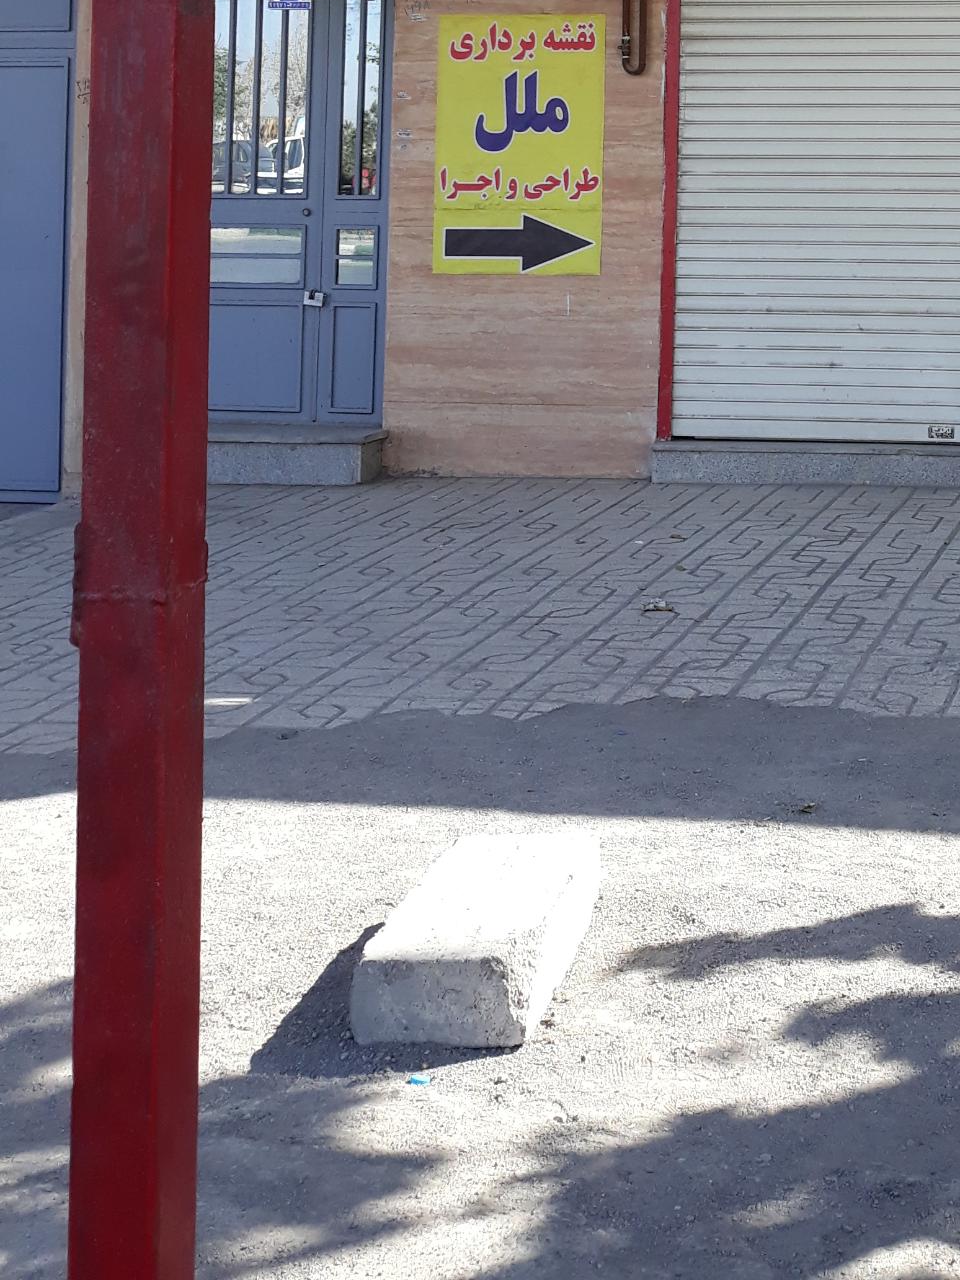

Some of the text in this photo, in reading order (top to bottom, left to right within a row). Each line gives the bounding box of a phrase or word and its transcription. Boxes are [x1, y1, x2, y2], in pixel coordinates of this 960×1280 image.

[449, 21, 597, 61] نقشه برداری
[475, 70, 571, 154] ملل
[440, 167, 600, 201] طراحی و اجرا
